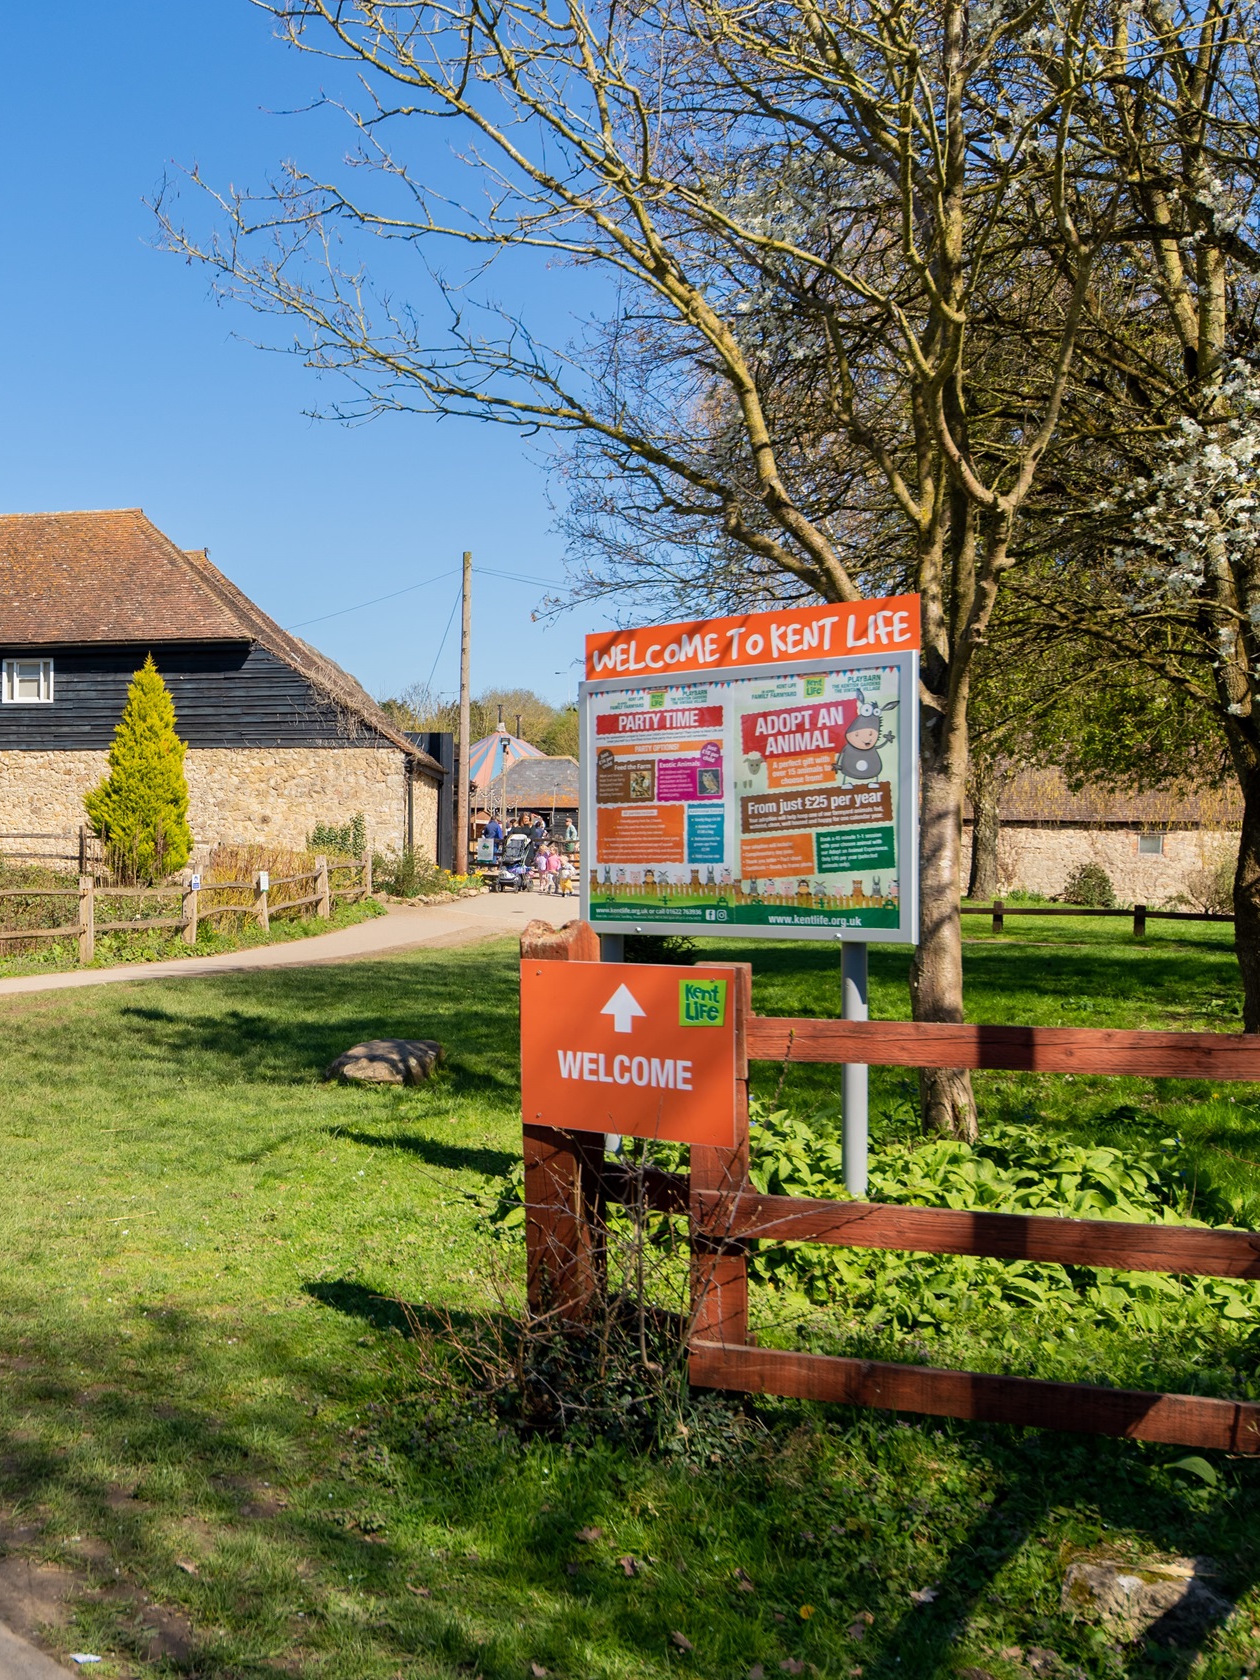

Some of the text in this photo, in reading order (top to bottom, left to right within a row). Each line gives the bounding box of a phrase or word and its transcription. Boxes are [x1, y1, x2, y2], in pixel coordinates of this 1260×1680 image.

[593, 633, 719, 672] WELCOME
[771, 616, 839, 659] KENT
[846, 611, 911, 648] LIFE
[847, 675, 881, 683] PLAYBARN
[618, 710, 699, 731] PARTY TIME
[755, 705, 844, 736] ADOPT AN
[634, 745, 652, 753] PARTY
[765, 729, 836, 756] ANIMAL
[772, 770, 787, 778] over
[797, 765, 823, 774] animals
[778, 759, 802, 770] perfect
[803, 757, 815, 767] gift
[815, 756, 830, 764] with
[780, 774, 824, 785] choose from!
[748, 791, 884, 815] From just £25 per year
[768, 914, 862, 928] www.kentlife.org.uk
[685, 983, 720, 1004] Kent
[557, 1049, 693, 1091] WELCOME
